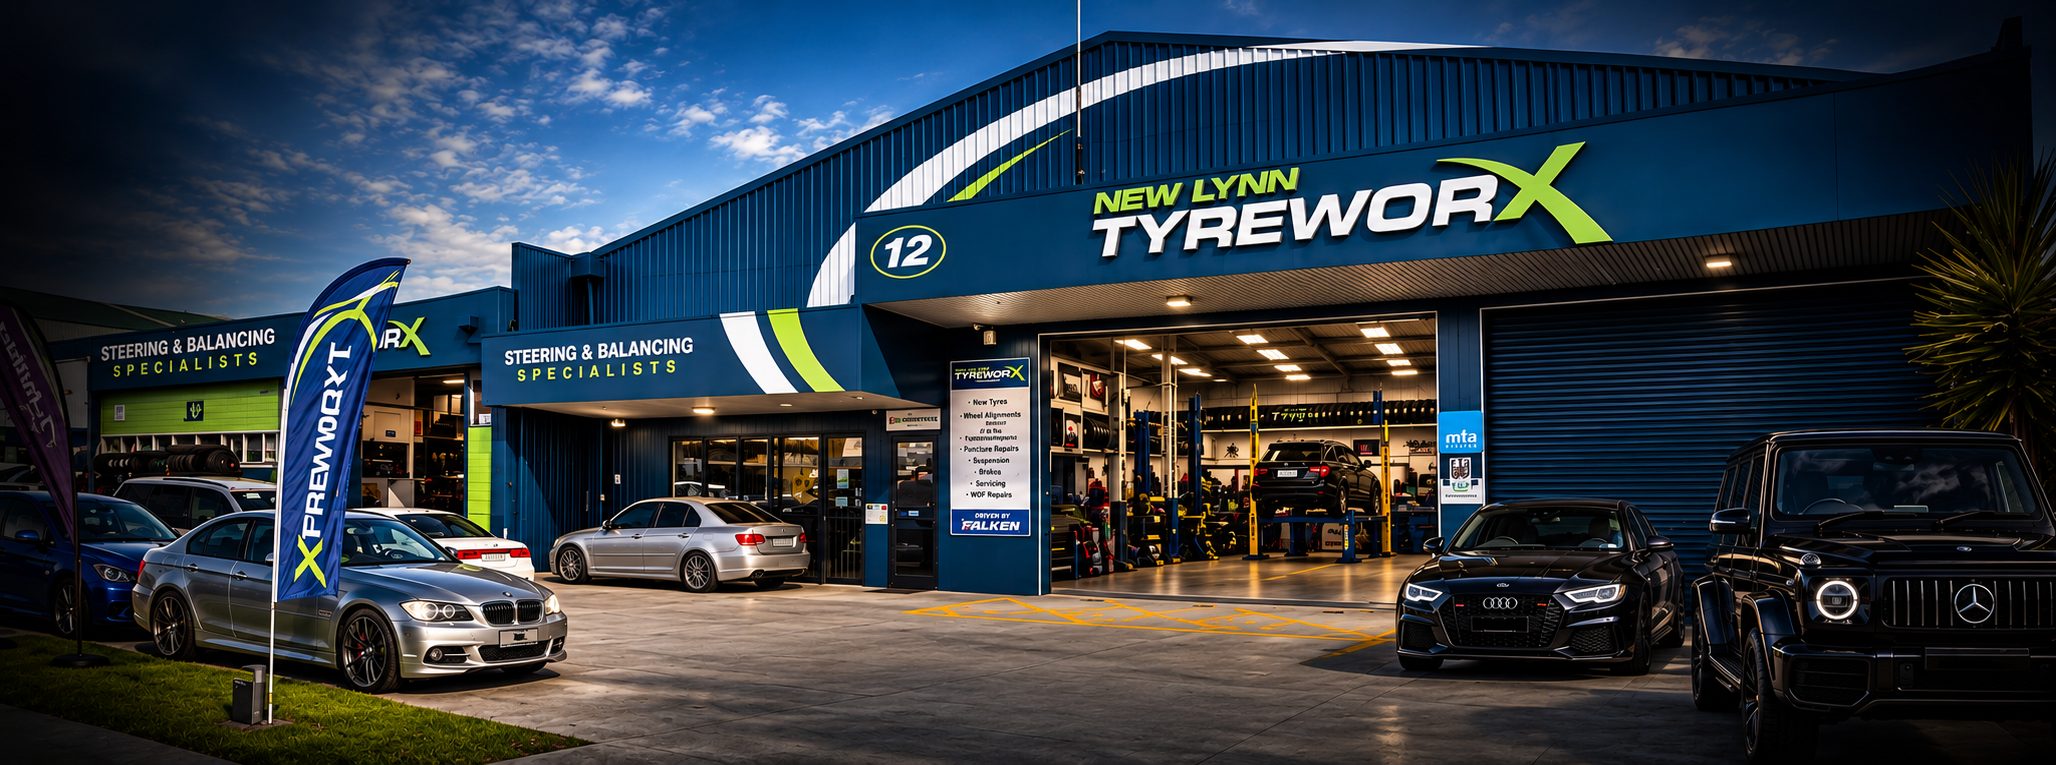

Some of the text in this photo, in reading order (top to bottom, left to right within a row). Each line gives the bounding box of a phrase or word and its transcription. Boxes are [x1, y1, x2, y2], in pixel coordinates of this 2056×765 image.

[1092, 141, 1614, 258] TYREWORX
[1093, 166, 1300, 215] NEW LYNN
[884, 234, 933, 269] 12
[101, 327, 276, 362] STEERING & BALANCING
[504, 337, 694, 366] STEERING & BALANCING
[113, 351, 258, 378] SPECIALISTS
[517, 359, 677, 382] SPECIALISTS
[989, 398, 1008, 407] Tyres
[963, 412, 983, 420] Wheel
[1445, 429, 1477, 444] mta
[987, 490, 1013, 499] Repairs
[961, 520, 1020, 531] FALKEN
